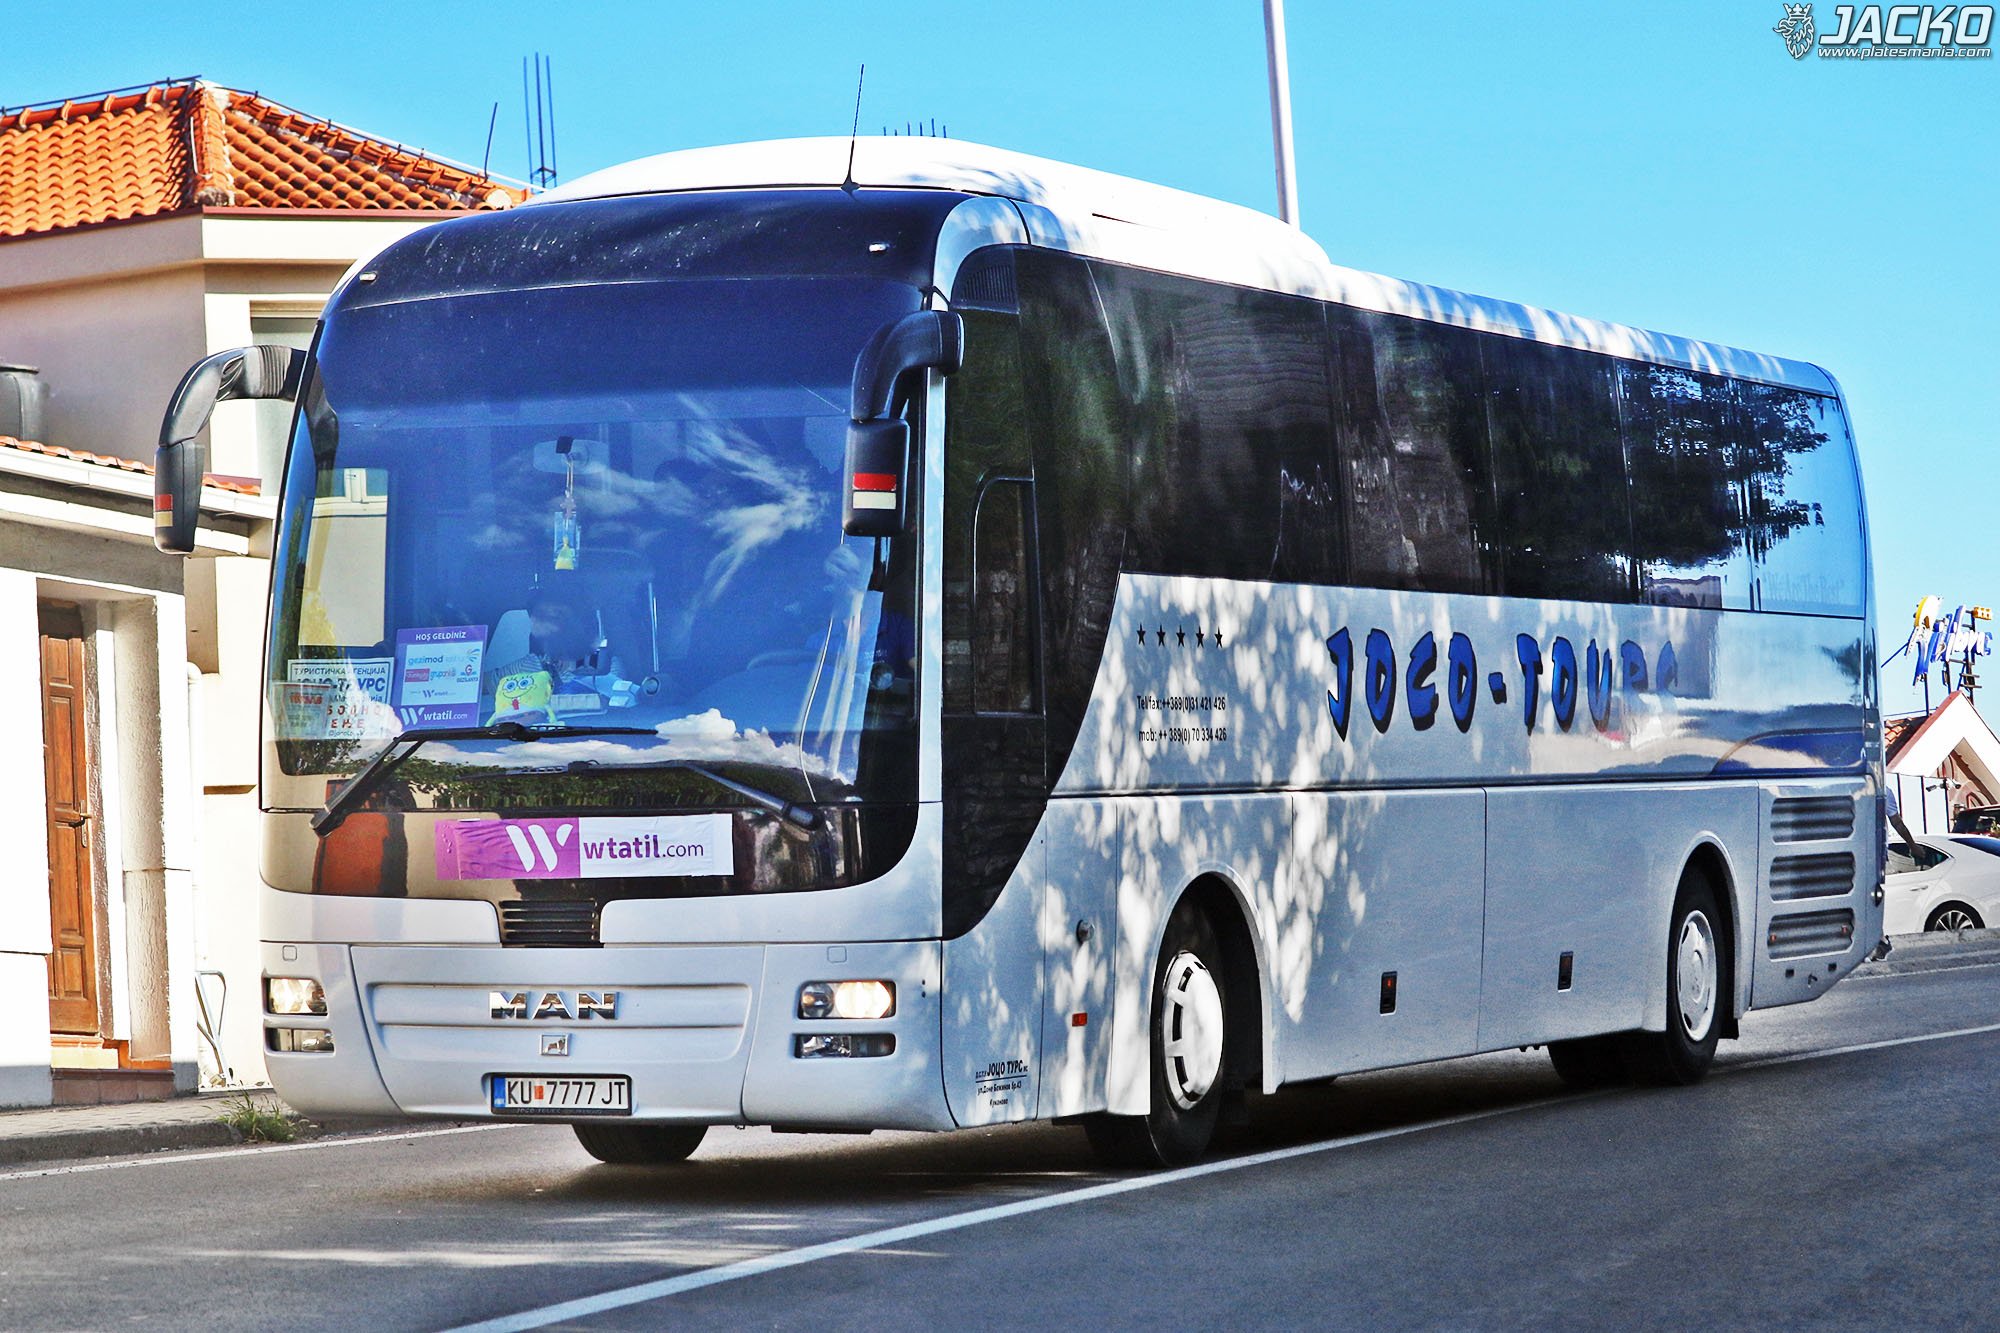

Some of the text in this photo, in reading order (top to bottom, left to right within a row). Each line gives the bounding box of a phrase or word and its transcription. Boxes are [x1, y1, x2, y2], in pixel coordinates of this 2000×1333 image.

[415, 631, 467, 642] HOŞ GELDİNİZ
[408, 655, 443, 665] gezimod
[293, 667, 386, 675] ТУРИСТИЧКА ГЕНЦИЈА
[1200, 697, 1212, 710] 421
[1213, 697, 1226, 710] 426
[424, 710, 468, 721] wtatil.com
[1138, 728, 1157, 742] mob:
[1192, 729, 1200, 741] 70
[1201, 728, 1213, 742] 334
[1215, 728, 1227, 742] 426
[583, 834, 704, 860] wtatil.com
[489, 991, 618, 1020] MAN
[1006, 1060, 1023, 1074] ТУРС
[507, 1080, 626, 1105] KU 7777 JT
